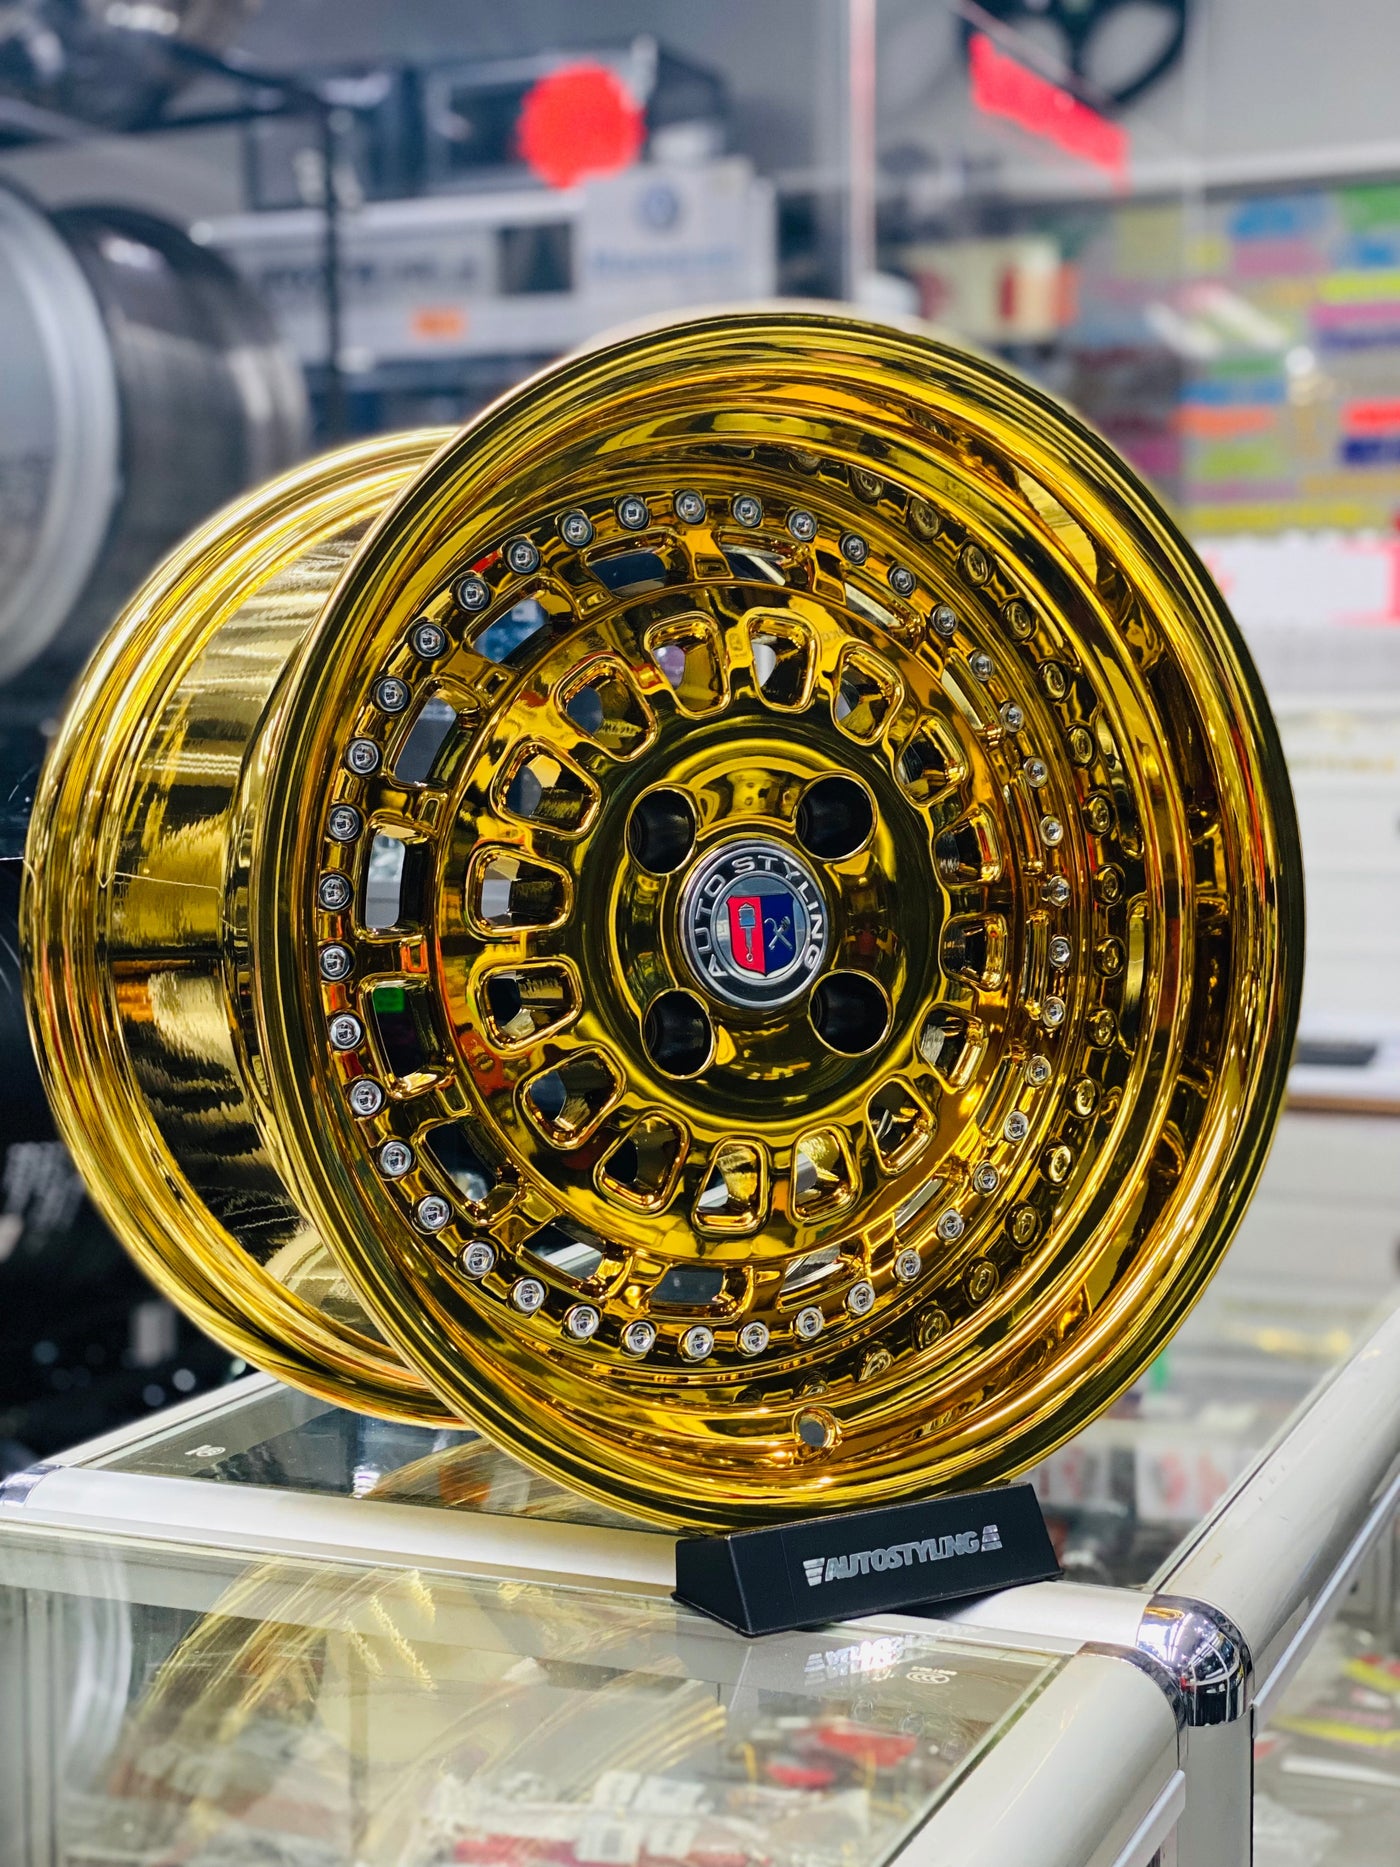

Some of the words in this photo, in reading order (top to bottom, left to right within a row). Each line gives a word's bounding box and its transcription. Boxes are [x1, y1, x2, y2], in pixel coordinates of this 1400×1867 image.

[694, 874, 728, 977] AUTO
[732, 855, 824, 970] STYLING
[824, 1531, 980, 1582] AUTOSTYLING
